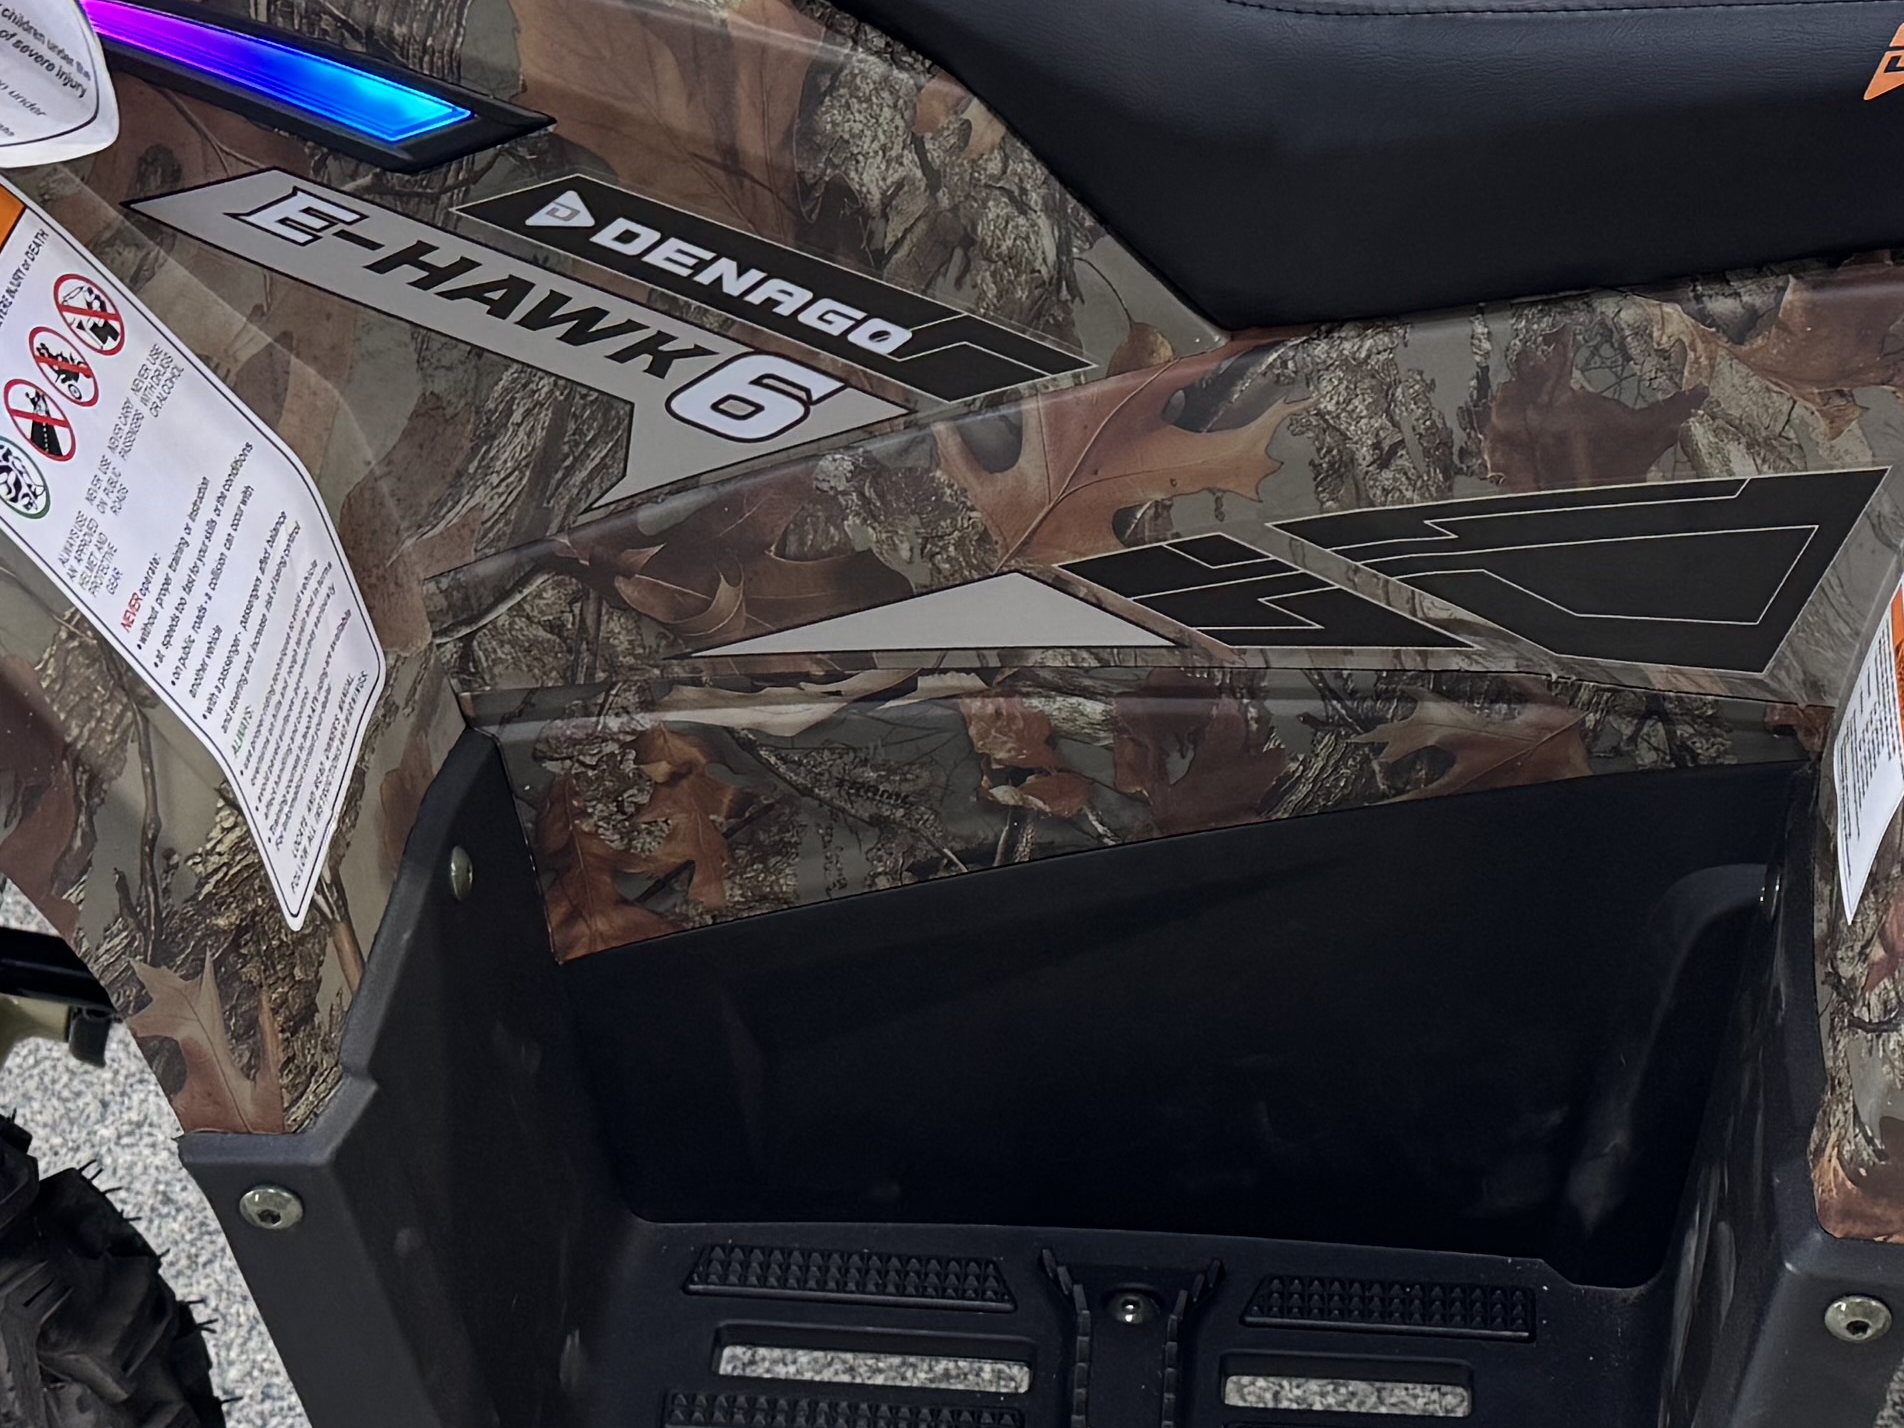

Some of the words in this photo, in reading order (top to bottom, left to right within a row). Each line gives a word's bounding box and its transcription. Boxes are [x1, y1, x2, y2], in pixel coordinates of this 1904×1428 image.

[0, 7, 44, 42] children
[12, 39, 55, 71] severe
[55, 66, 86, 98] injury
[7, 90, 46, 115] under
[24, 228, 48, 261] DEATH
[21, 258, 30, 271] or
[5, 266, 25, 299] INJURY
[590, 216, 914, 358] DENAGO
[226, 186, 718, 380] E-HAWK
[665, 353, 847, 443] 6
[130, 363, 151, 395] NEVER
[146, 342, 163, 365] USE
[140, 381, 156, 406] WITH
[150, 352, 173, 386] DRUGS
[149, 400, 162, 417] OR
[156, 364, 184, 405] ALCOHOL
[107, 423, 124, 453] NEVER
[118, 396, 133, 426] CARRY
[118, 409, 144, 460] PASSENGERS
[85, 474, 102, 505] NEVER
[97, 454, 111, 474] USE
[222, 442, 252, 491] conditions
[96, 497, 108, 514] ON
[102, 466, 121, 498] PUBLIC
[109, 483, 128, 515] ROADS
[187, 476, 209, 522] instruction
[215, 490, 227, 507] the
[239, 485, 254, 506] with
[213, 503, 221, 517] or
[230, 504, 243, 531] occur
[58, 527, 79, 567] ALWAYS
[73, 510, 87, 532] USE
[183, 522, 192, 535] or
[204, 517, 217, 542] skills
[223, 532, 234, 551] can
[66, 564, 78, 582] AN
[73, 517, 98, 563] APPROVED
[78, 550, 98, 590] HELMET
[93, 531, 108, 554] AND
[167, 536, 189, 572] training
[195, 539, 208, 566] your
[88, 541, 117, 597] PROTECTIVE
[105, 567, 122, 595] GEAR
[181, 573, 196, 595] fast
[188, 560, 199, 577] for
[208, 552, 227, 590] collision
[155, 572, 172, 609] proper
[174, 596, 187, 614] too
[120, 592, 142, 632] NEVER
[138, 605, 158, 644] without
[191, 604, 207, 633] roads
[161, 613, 180, 649] speeds
[155, 649, 165, 663] at
[177, 634, 195, 669] public
[189, 657, 208, 698] another
[204, 624, 222, 659] vehicle
[172, 664, 183, 680] on
[204, 692, 219, 714] with
